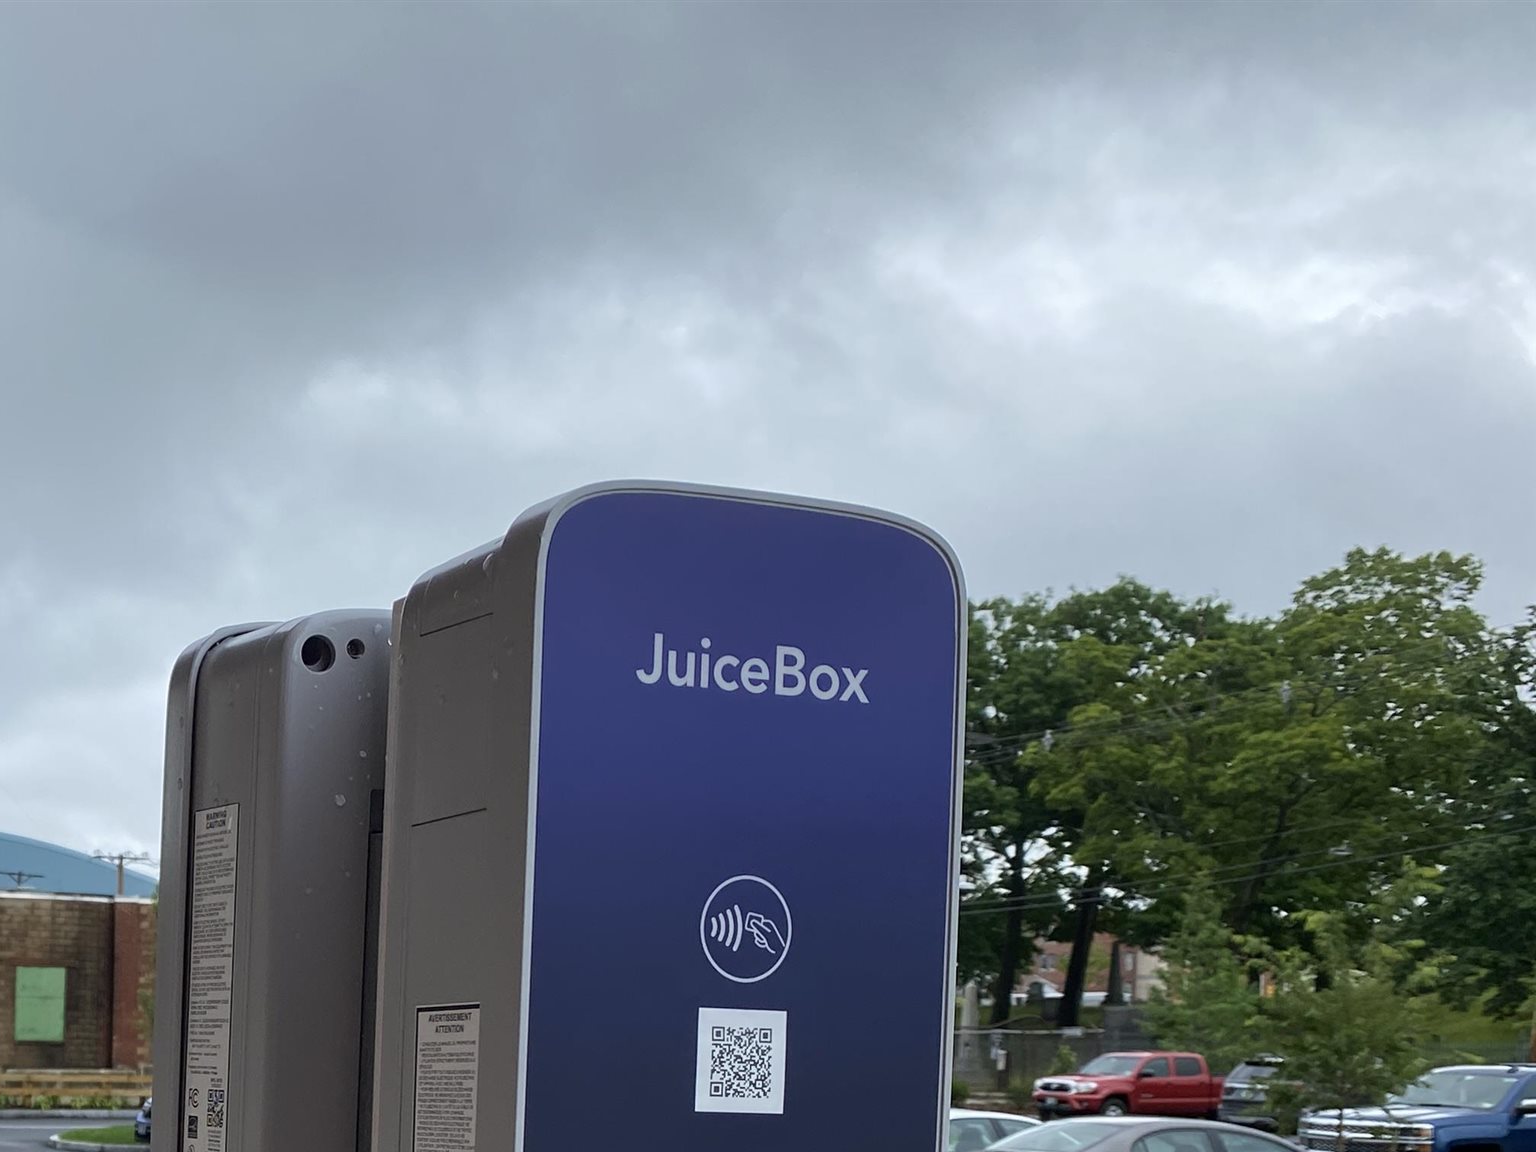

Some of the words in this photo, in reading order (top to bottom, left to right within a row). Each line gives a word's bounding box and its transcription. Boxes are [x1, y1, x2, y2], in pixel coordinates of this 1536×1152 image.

[635, 632, 870, 704] JuiceBox
[428, 1012, 472, 1023] AVERTISSEMENT
[435, 1024, 464, 1034] ATTENTION
